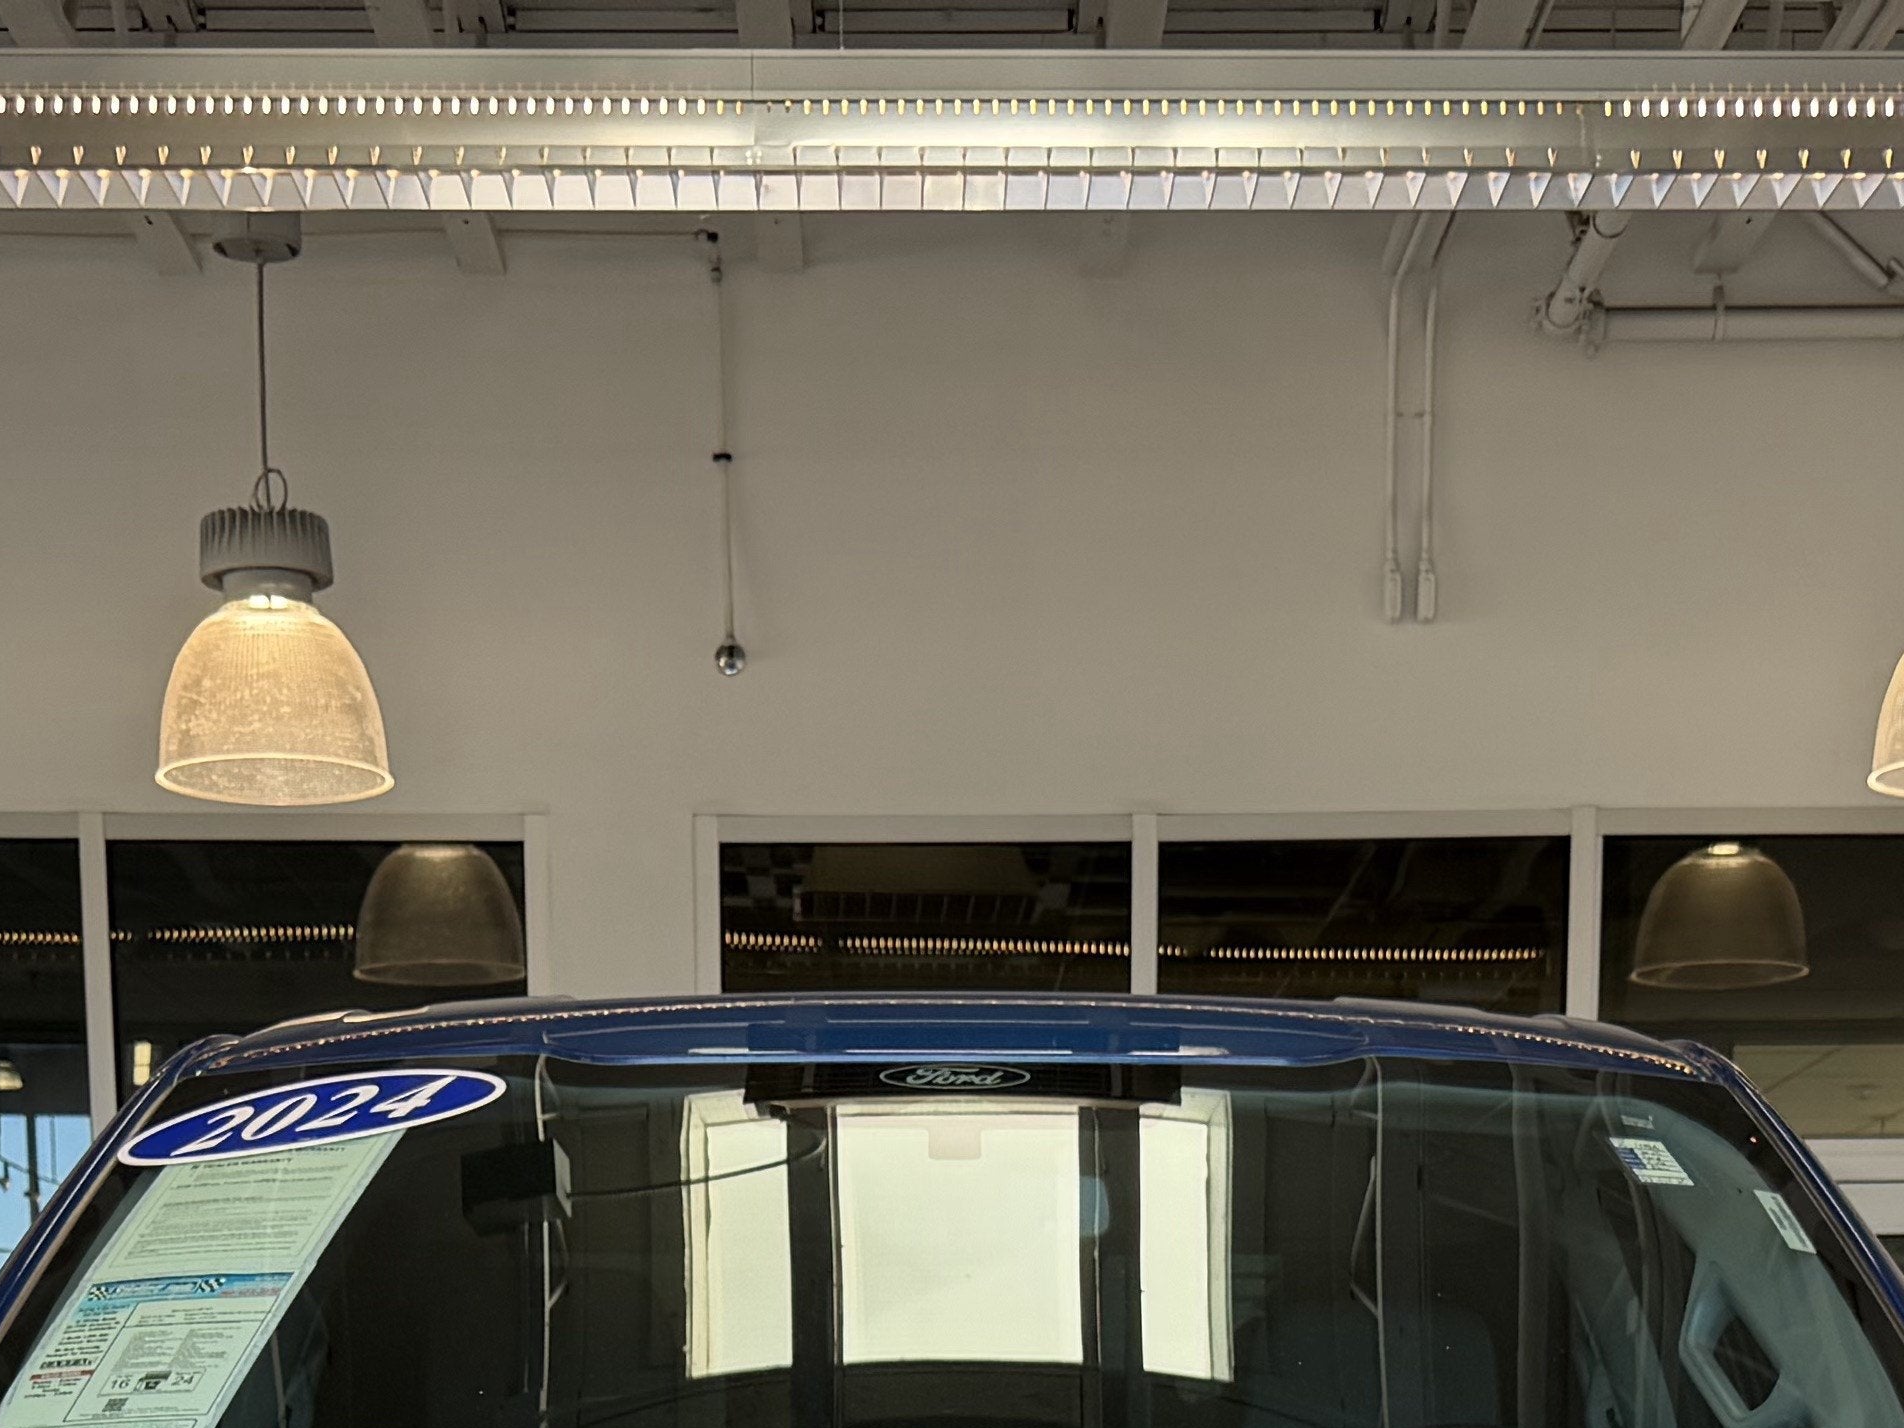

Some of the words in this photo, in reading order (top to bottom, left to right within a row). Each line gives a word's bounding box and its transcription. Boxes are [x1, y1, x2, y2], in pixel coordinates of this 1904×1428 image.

[905, 1067, 1005, 1085] Ford
[169, 1074, 459, 1157] 2024
[110, 1378, 131, 1390] 16
